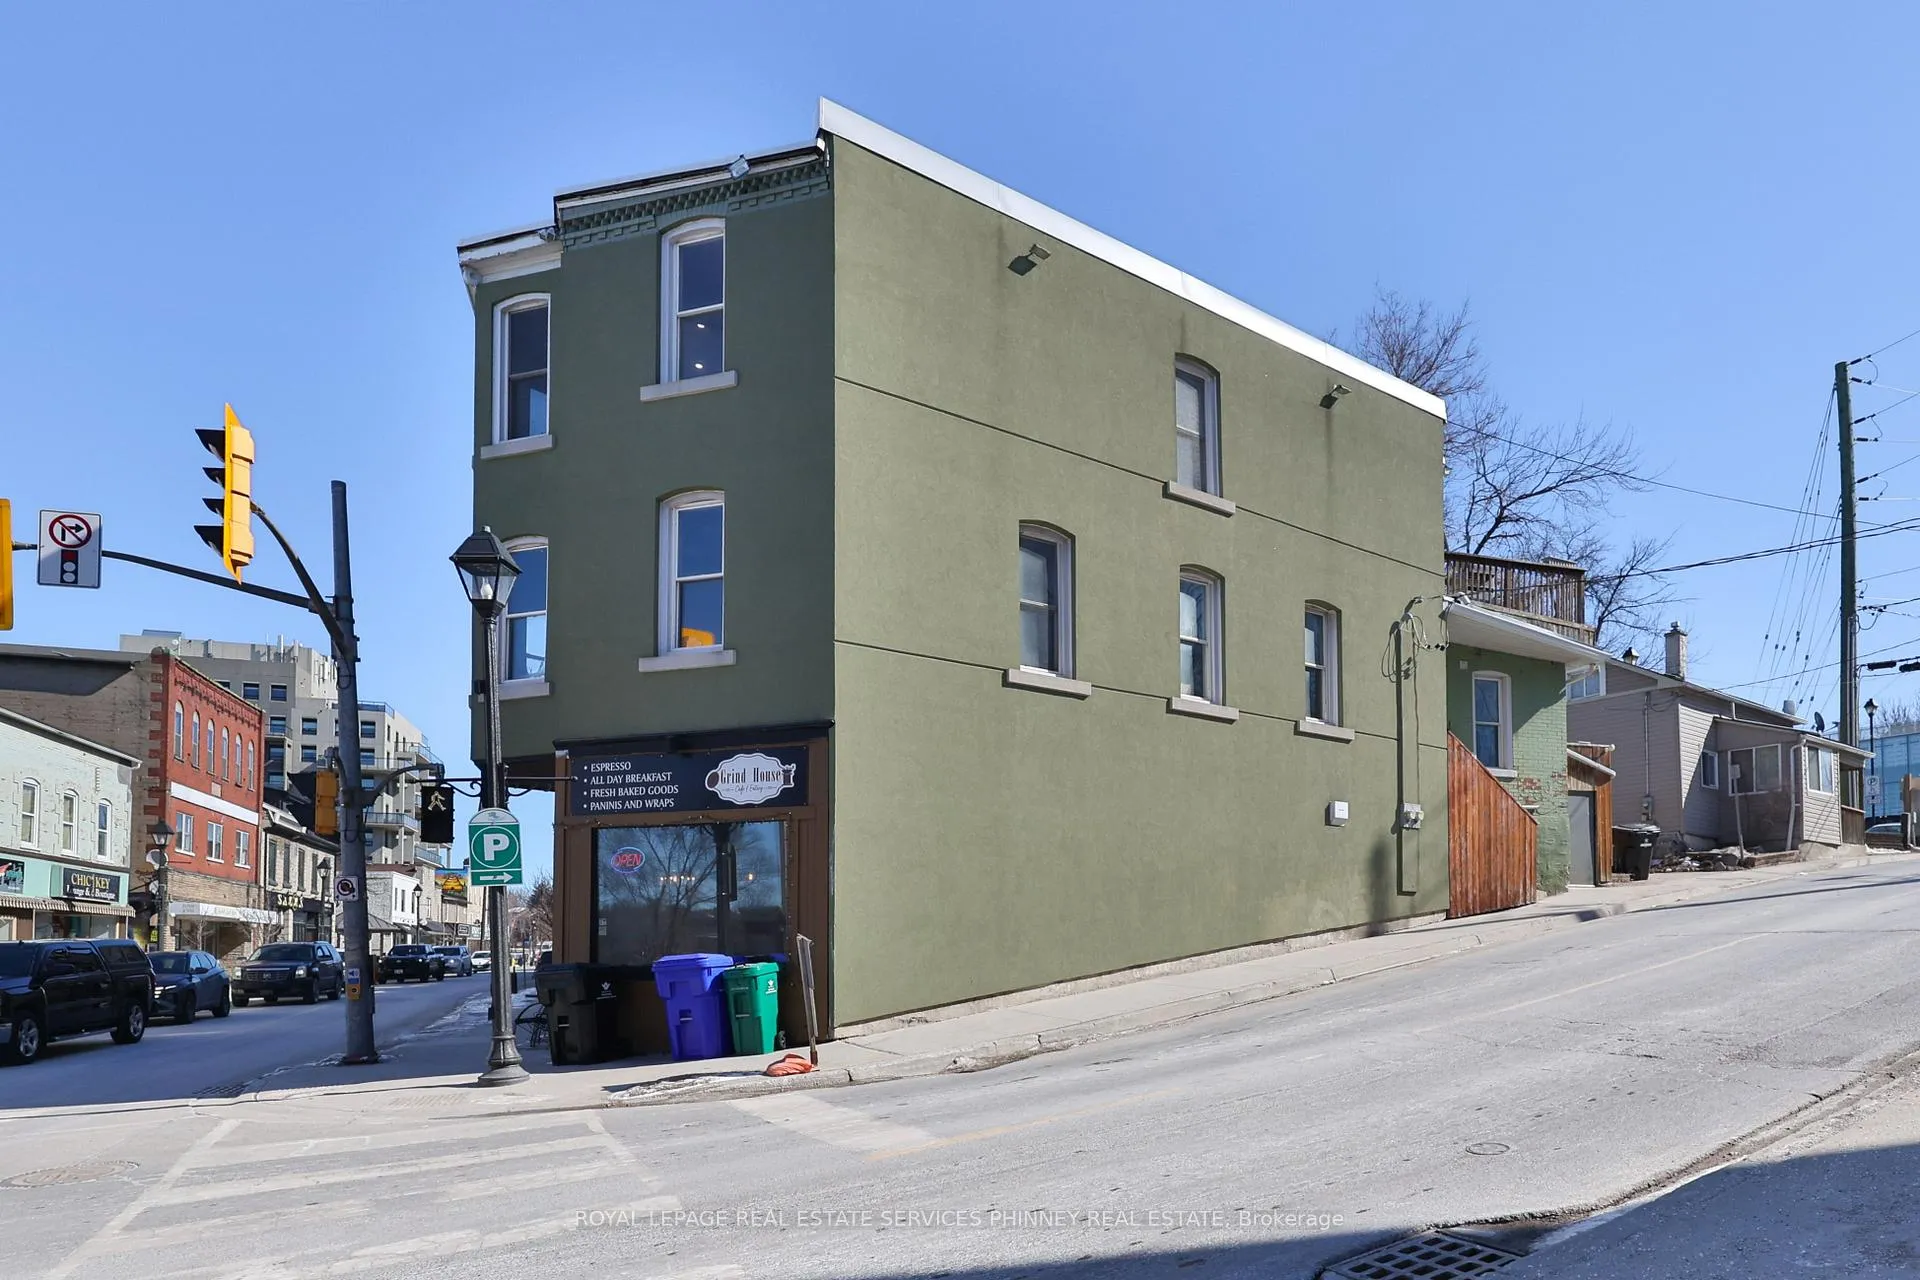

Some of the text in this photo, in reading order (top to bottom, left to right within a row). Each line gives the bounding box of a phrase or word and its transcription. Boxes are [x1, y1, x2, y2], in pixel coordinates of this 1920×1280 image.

[590, 761, 631, 772] ESPRESSO
[590, 771, 672, 785] ALL DAY BREAKFAST
[720, 767, 781, 785] Grind House
[590, 784, 679, 798] FRESH BAKED GOODS
[590, 798, 675, 811] PANINIS AND WRAPS
[483, 833, 510, 861] P
[613, 853, 642, 867] OPEN
[95, 877, 111, 889] KEY
